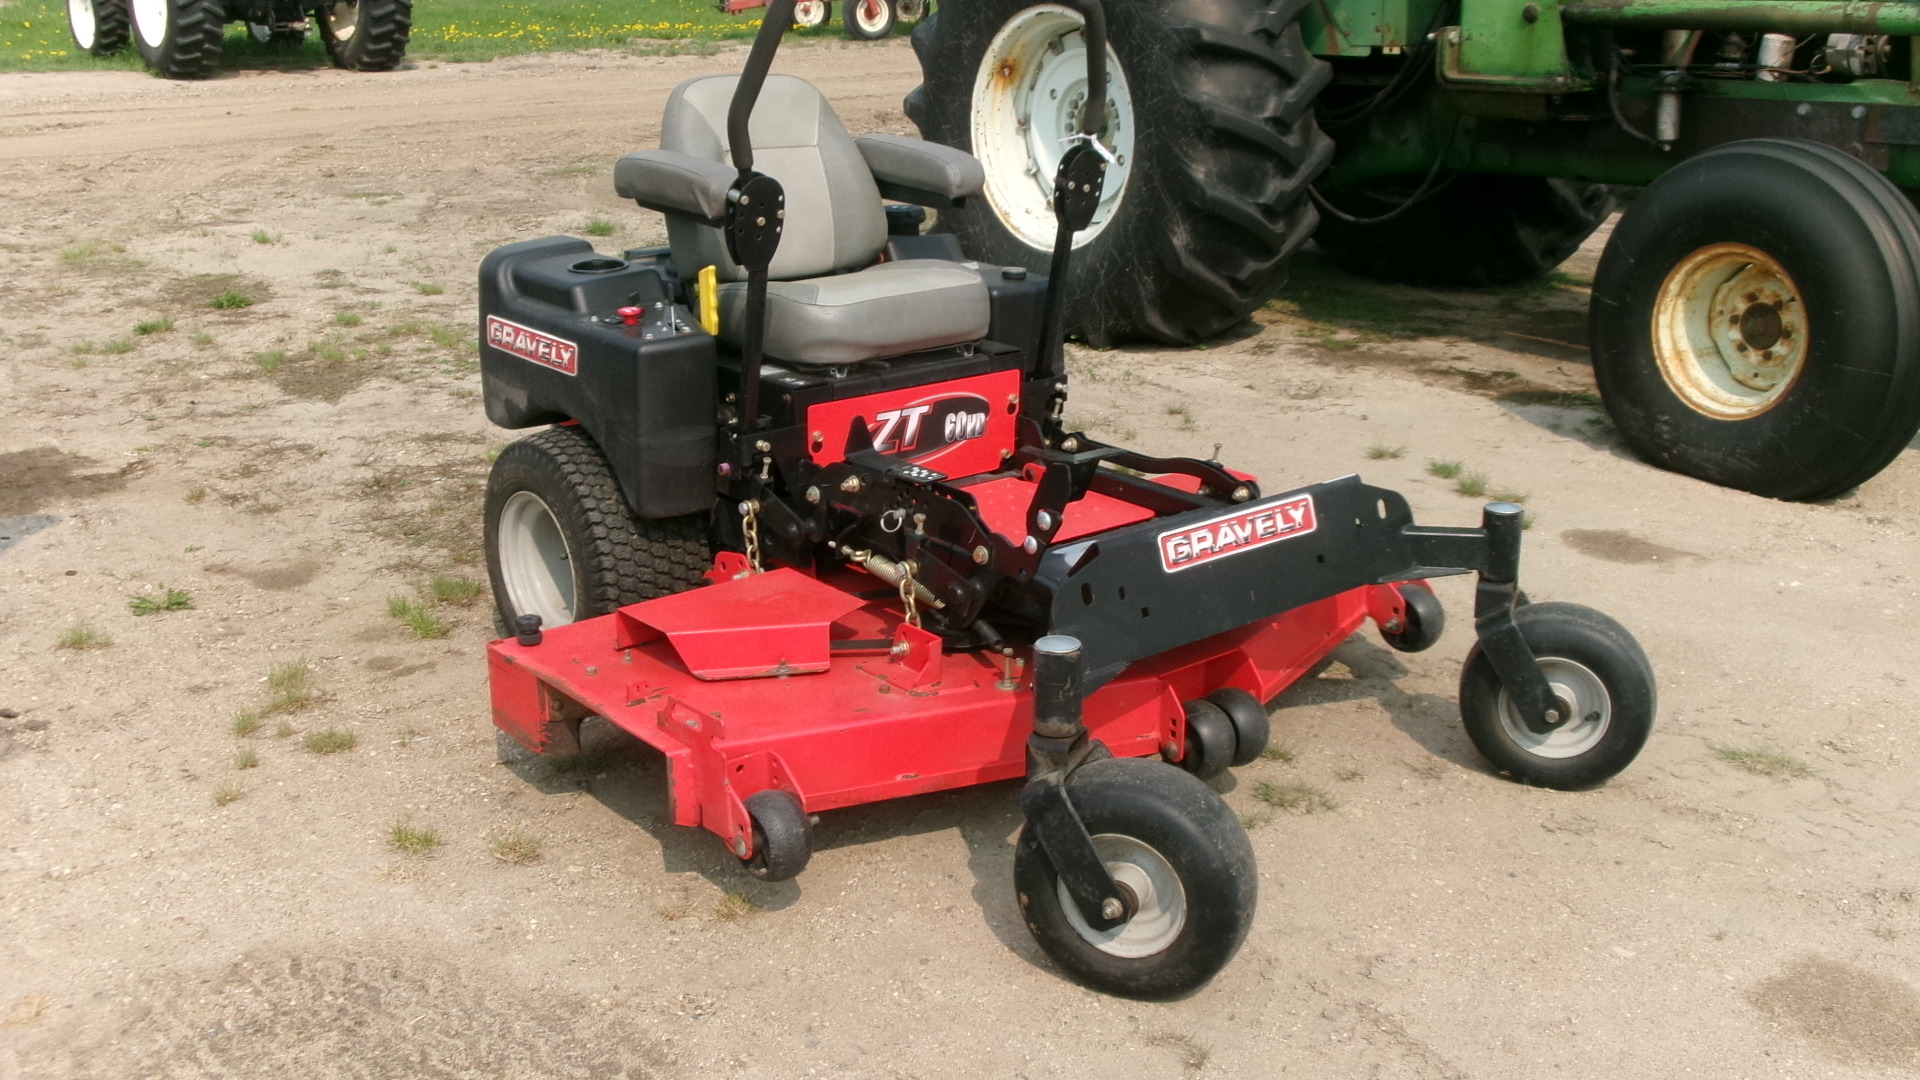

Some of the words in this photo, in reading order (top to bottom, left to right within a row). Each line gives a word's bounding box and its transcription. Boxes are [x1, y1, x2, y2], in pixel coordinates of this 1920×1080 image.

[490, 322, 575, 367] GRAVELY
[872, 404, 931, 452] ZT
[944, 411, 987, 443] 60HD
[1166, 501, 1309, 564] GRAVELY
